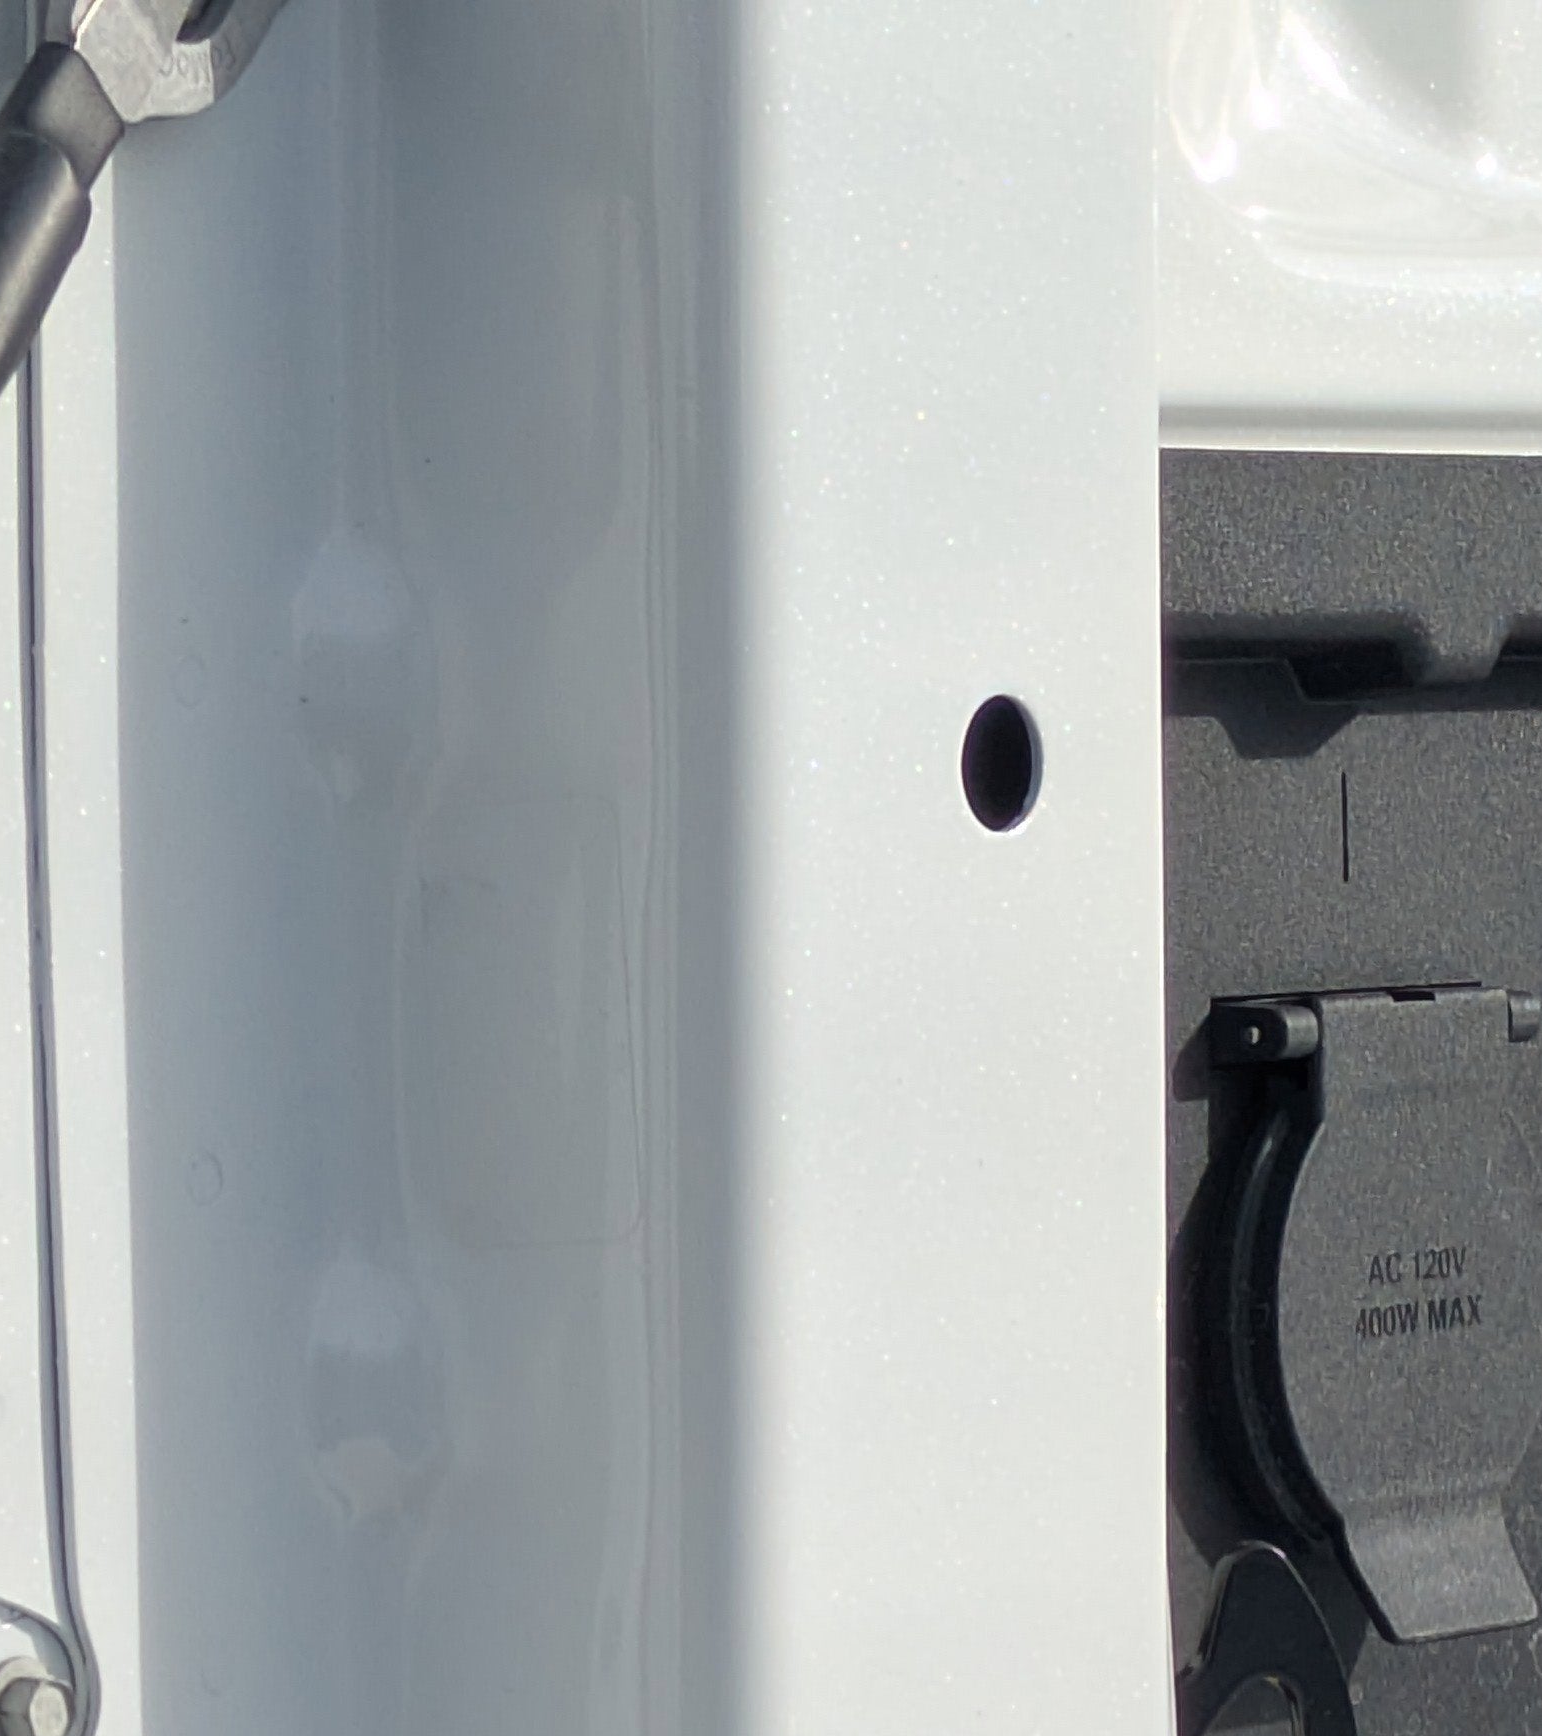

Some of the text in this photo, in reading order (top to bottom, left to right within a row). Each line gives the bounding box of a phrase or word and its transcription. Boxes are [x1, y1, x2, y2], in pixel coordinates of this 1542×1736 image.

[1368, 1246, 1468, 1286] AC 120V
[1355, 1294, 1484, 1339] 400W MAX
